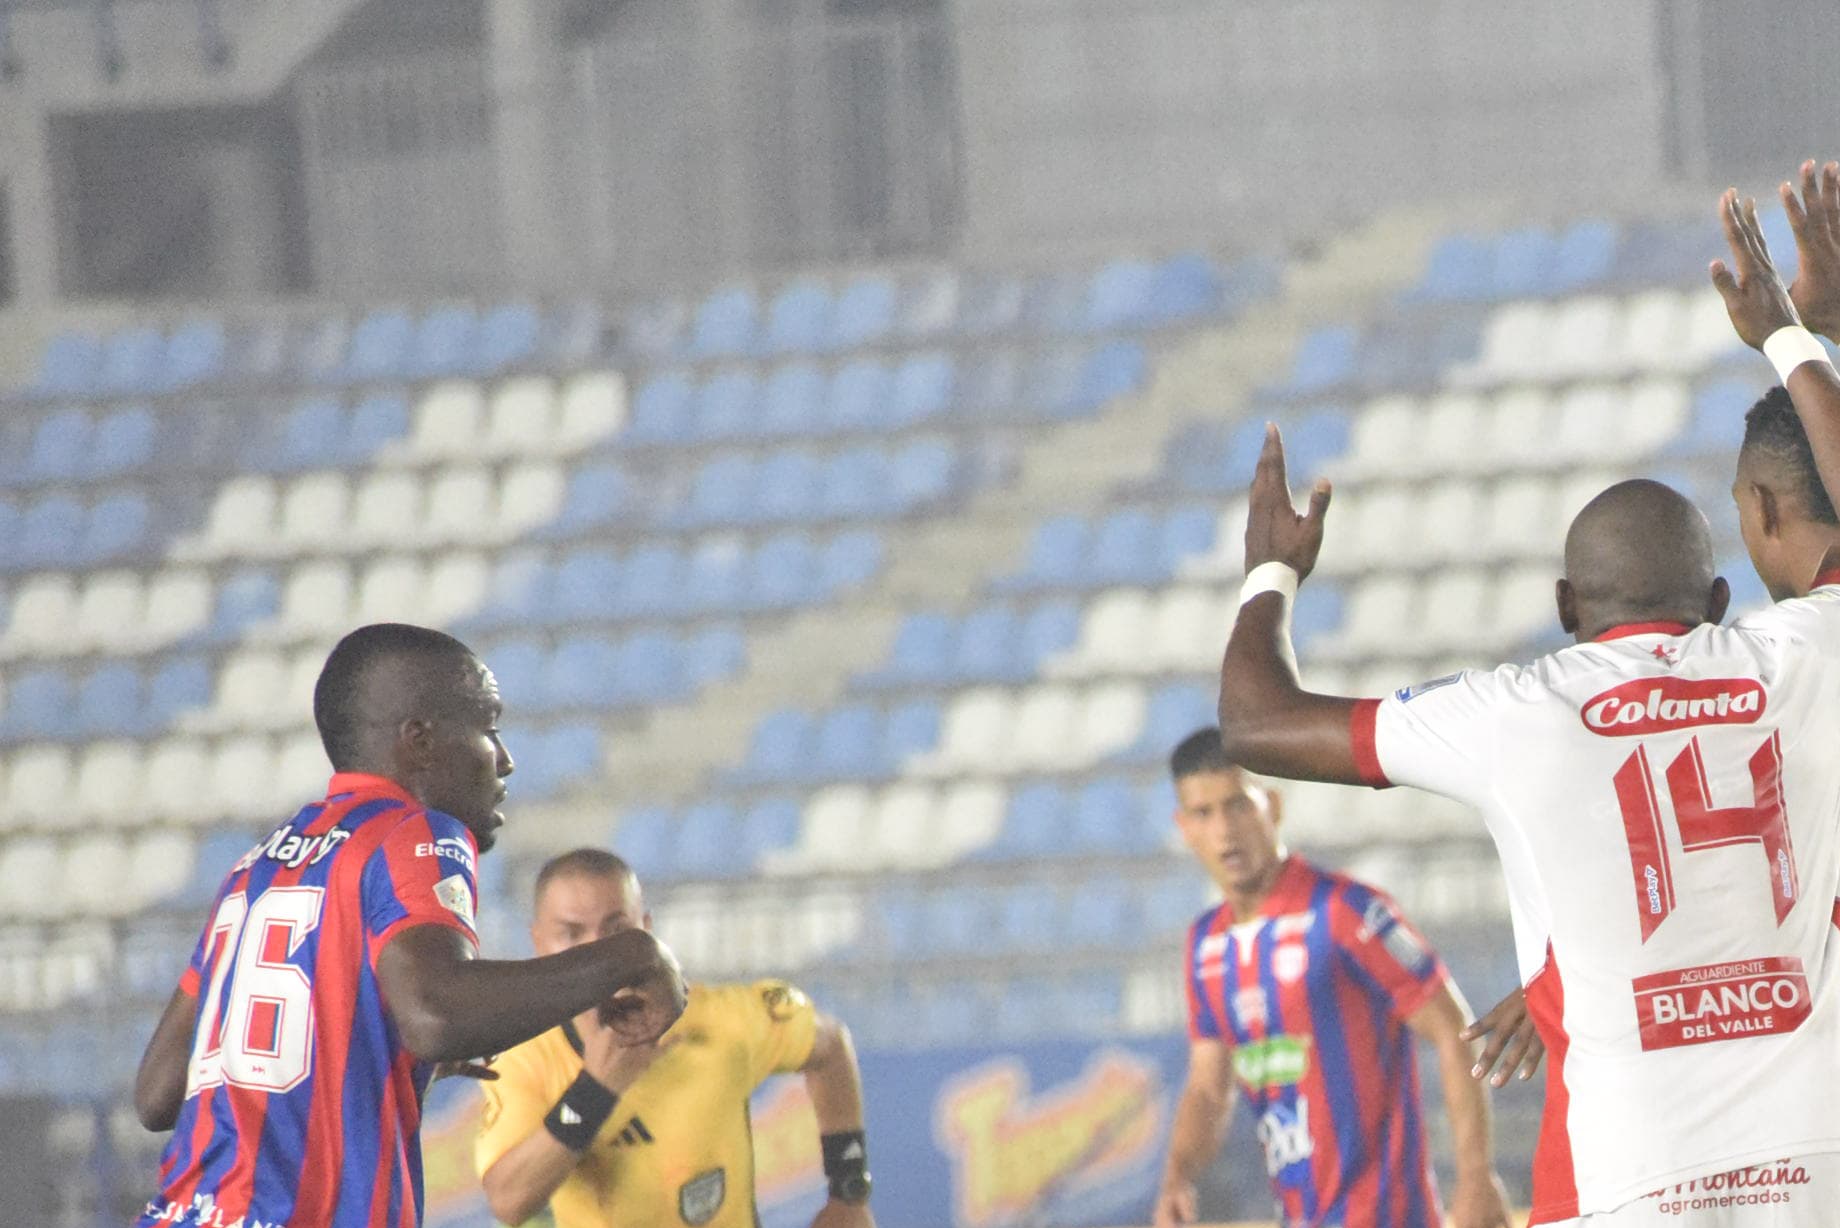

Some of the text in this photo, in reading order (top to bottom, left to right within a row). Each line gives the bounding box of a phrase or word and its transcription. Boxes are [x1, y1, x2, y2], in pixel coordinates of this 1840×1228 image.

[1585, 689, 1760, 728] Colanta
[1613, 727, 1798, 945] 14
[1680, 961, 1766, 983] AGUARDIENTE
[185, 886, 326, 1100] 26
[1653, 979, 1800, 1024] BLANCO
[1682, 1016, 1774, 1039] DEL VALLE
[1659, 1190, 1790, 1215] agromercados
